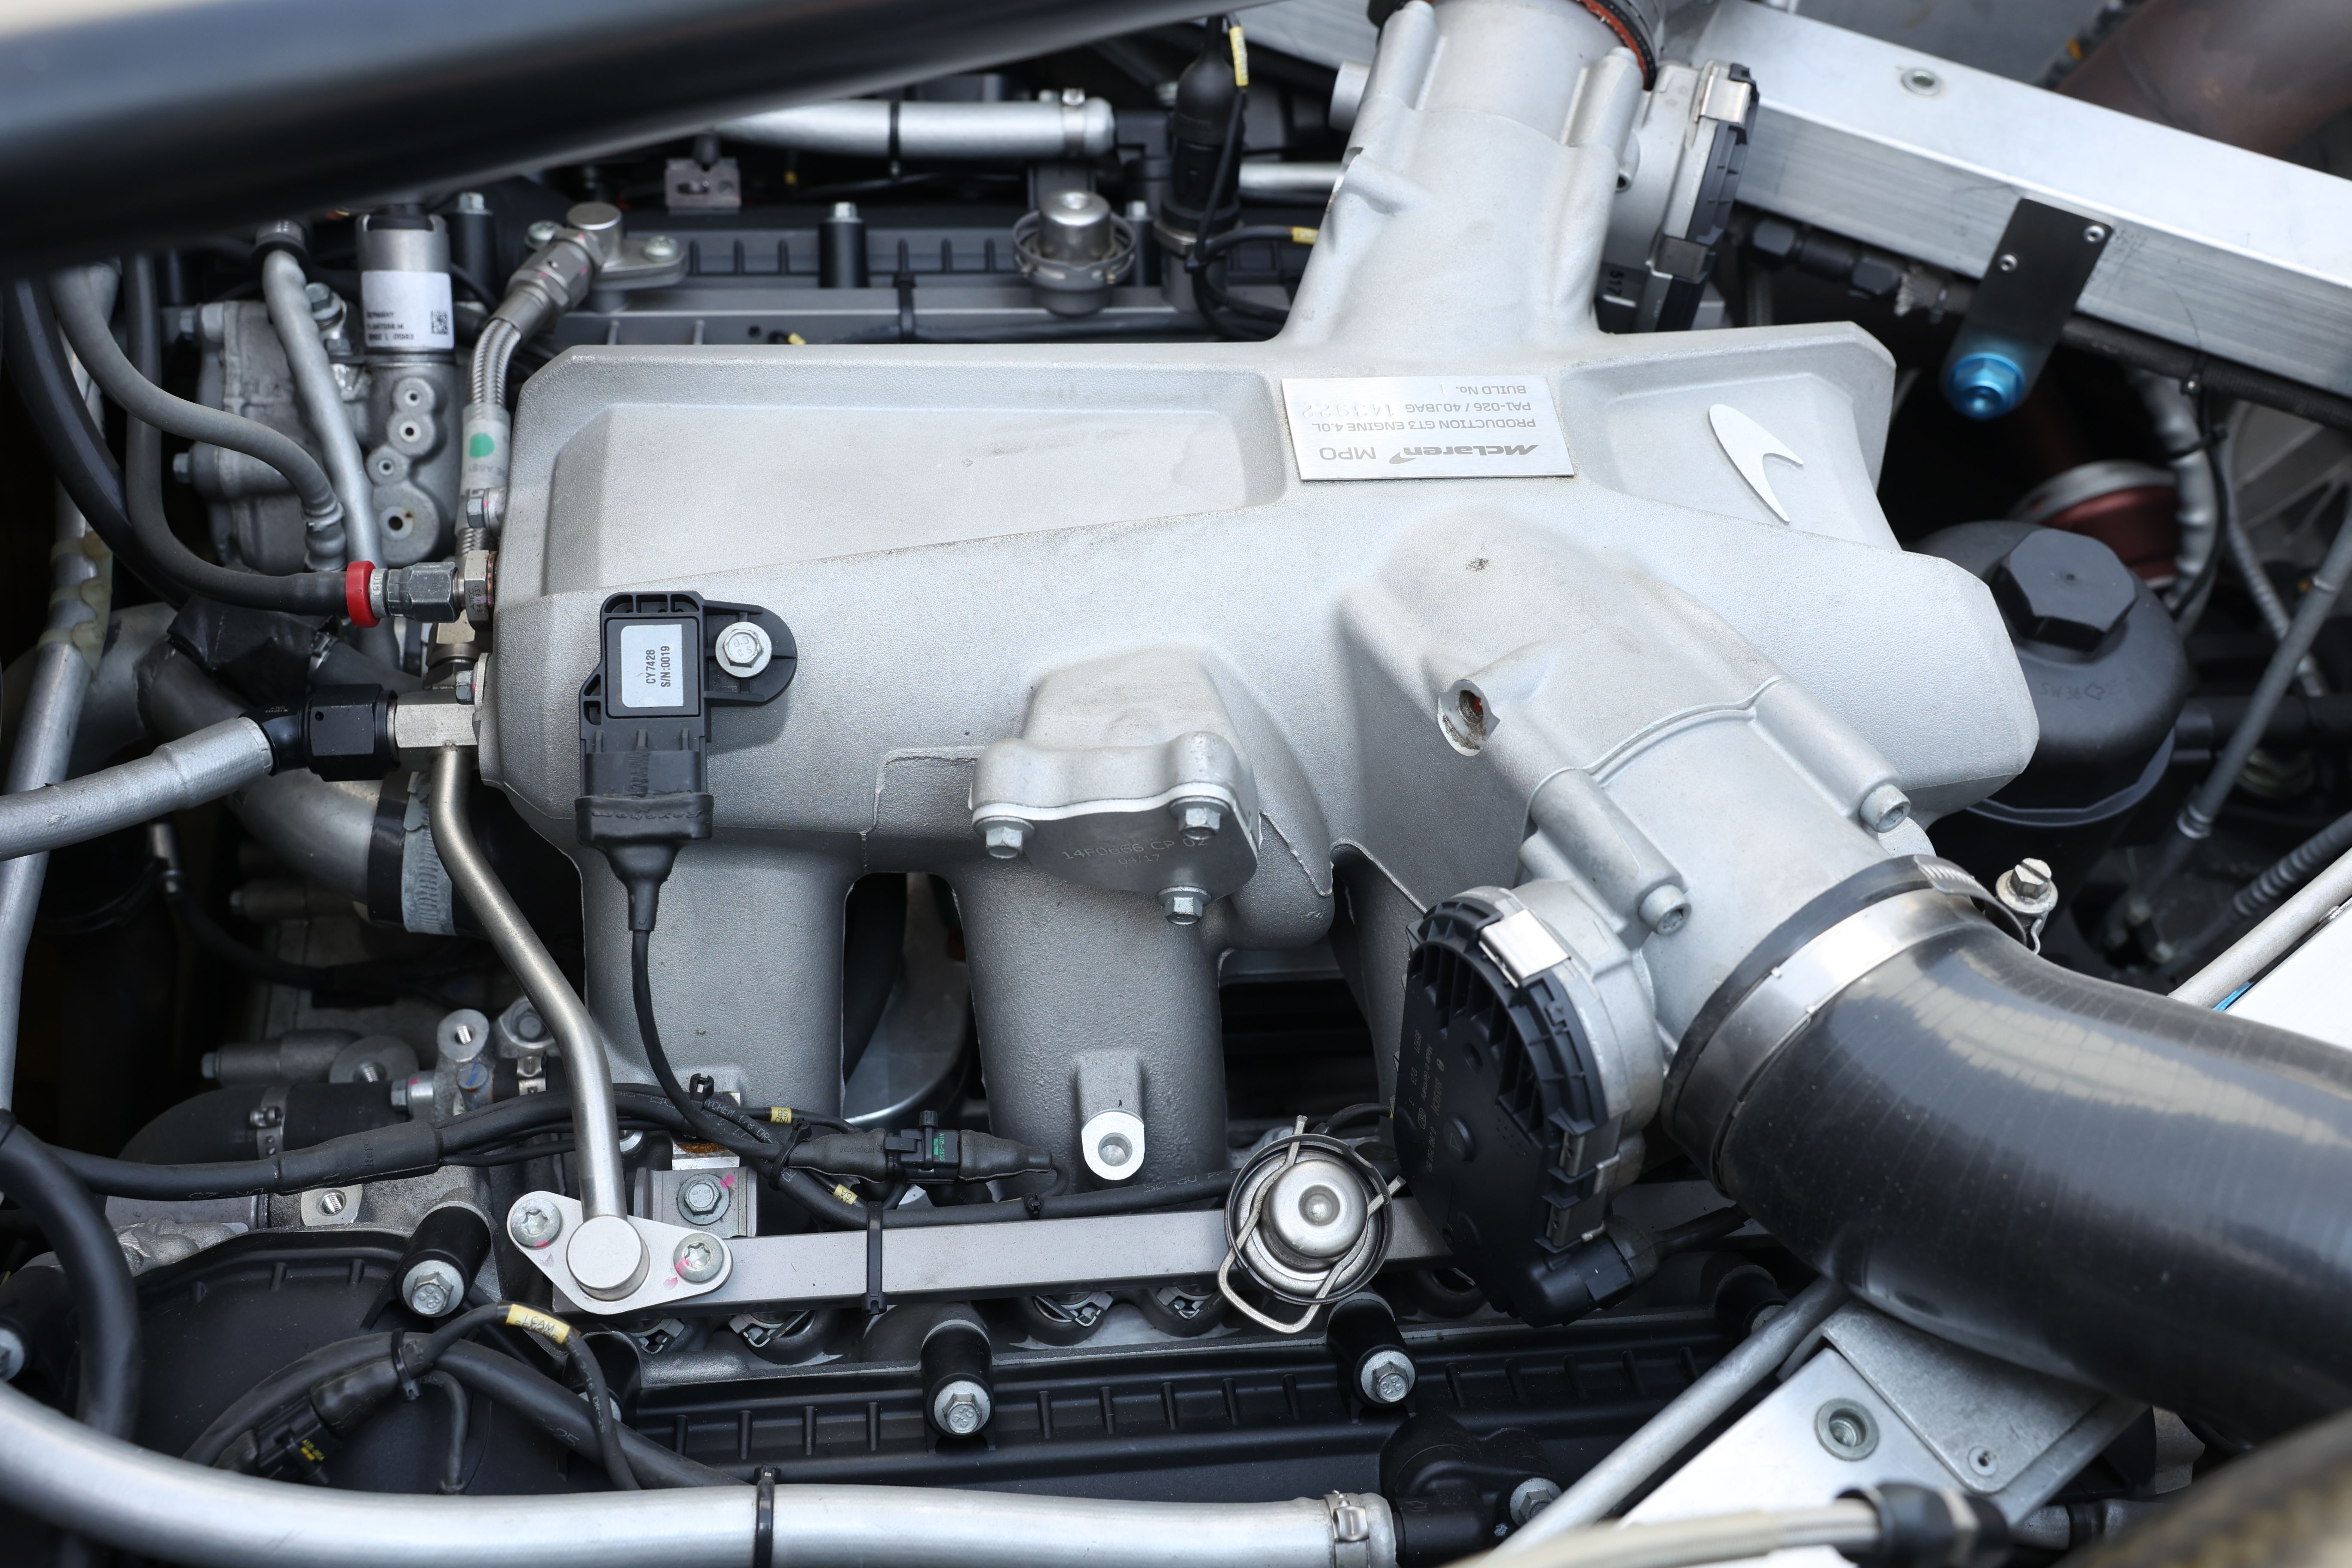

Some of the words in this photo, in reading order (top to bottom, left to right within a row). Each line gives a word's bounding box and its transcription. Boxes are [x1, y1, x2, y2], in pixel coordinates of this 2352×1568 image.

[1456, 386, 1479, 396] No.
[1481, 385, 1526, 395] BUILD
[1405, 403, 1462, 413] 40JBAG
[1473, 402, 1531, 413] PA1-026
[1312, 422, 1344, 432] 4.0L
[1346, 421, 1405, 431] ENGINE
[1408, 420, 1436, 430] GT3
[1438, 418, 1536, 429] PRODUCTION
[1318, 446, 1376, 461] MPO
[1402, 444, 1539, 458] McLaren
[660, 646, 671, 688] S/N:0019
[1149, 840, 1175, 851] CP
[1118, 853, 1161, 866] 04/17
[1431, 1077, 1442, 1116] BOSCH
[777, 1109, 788, 1117] 5B
[841, 1188, 852, 1200] 6A
[530, 1316, 556, 1332] CAM
